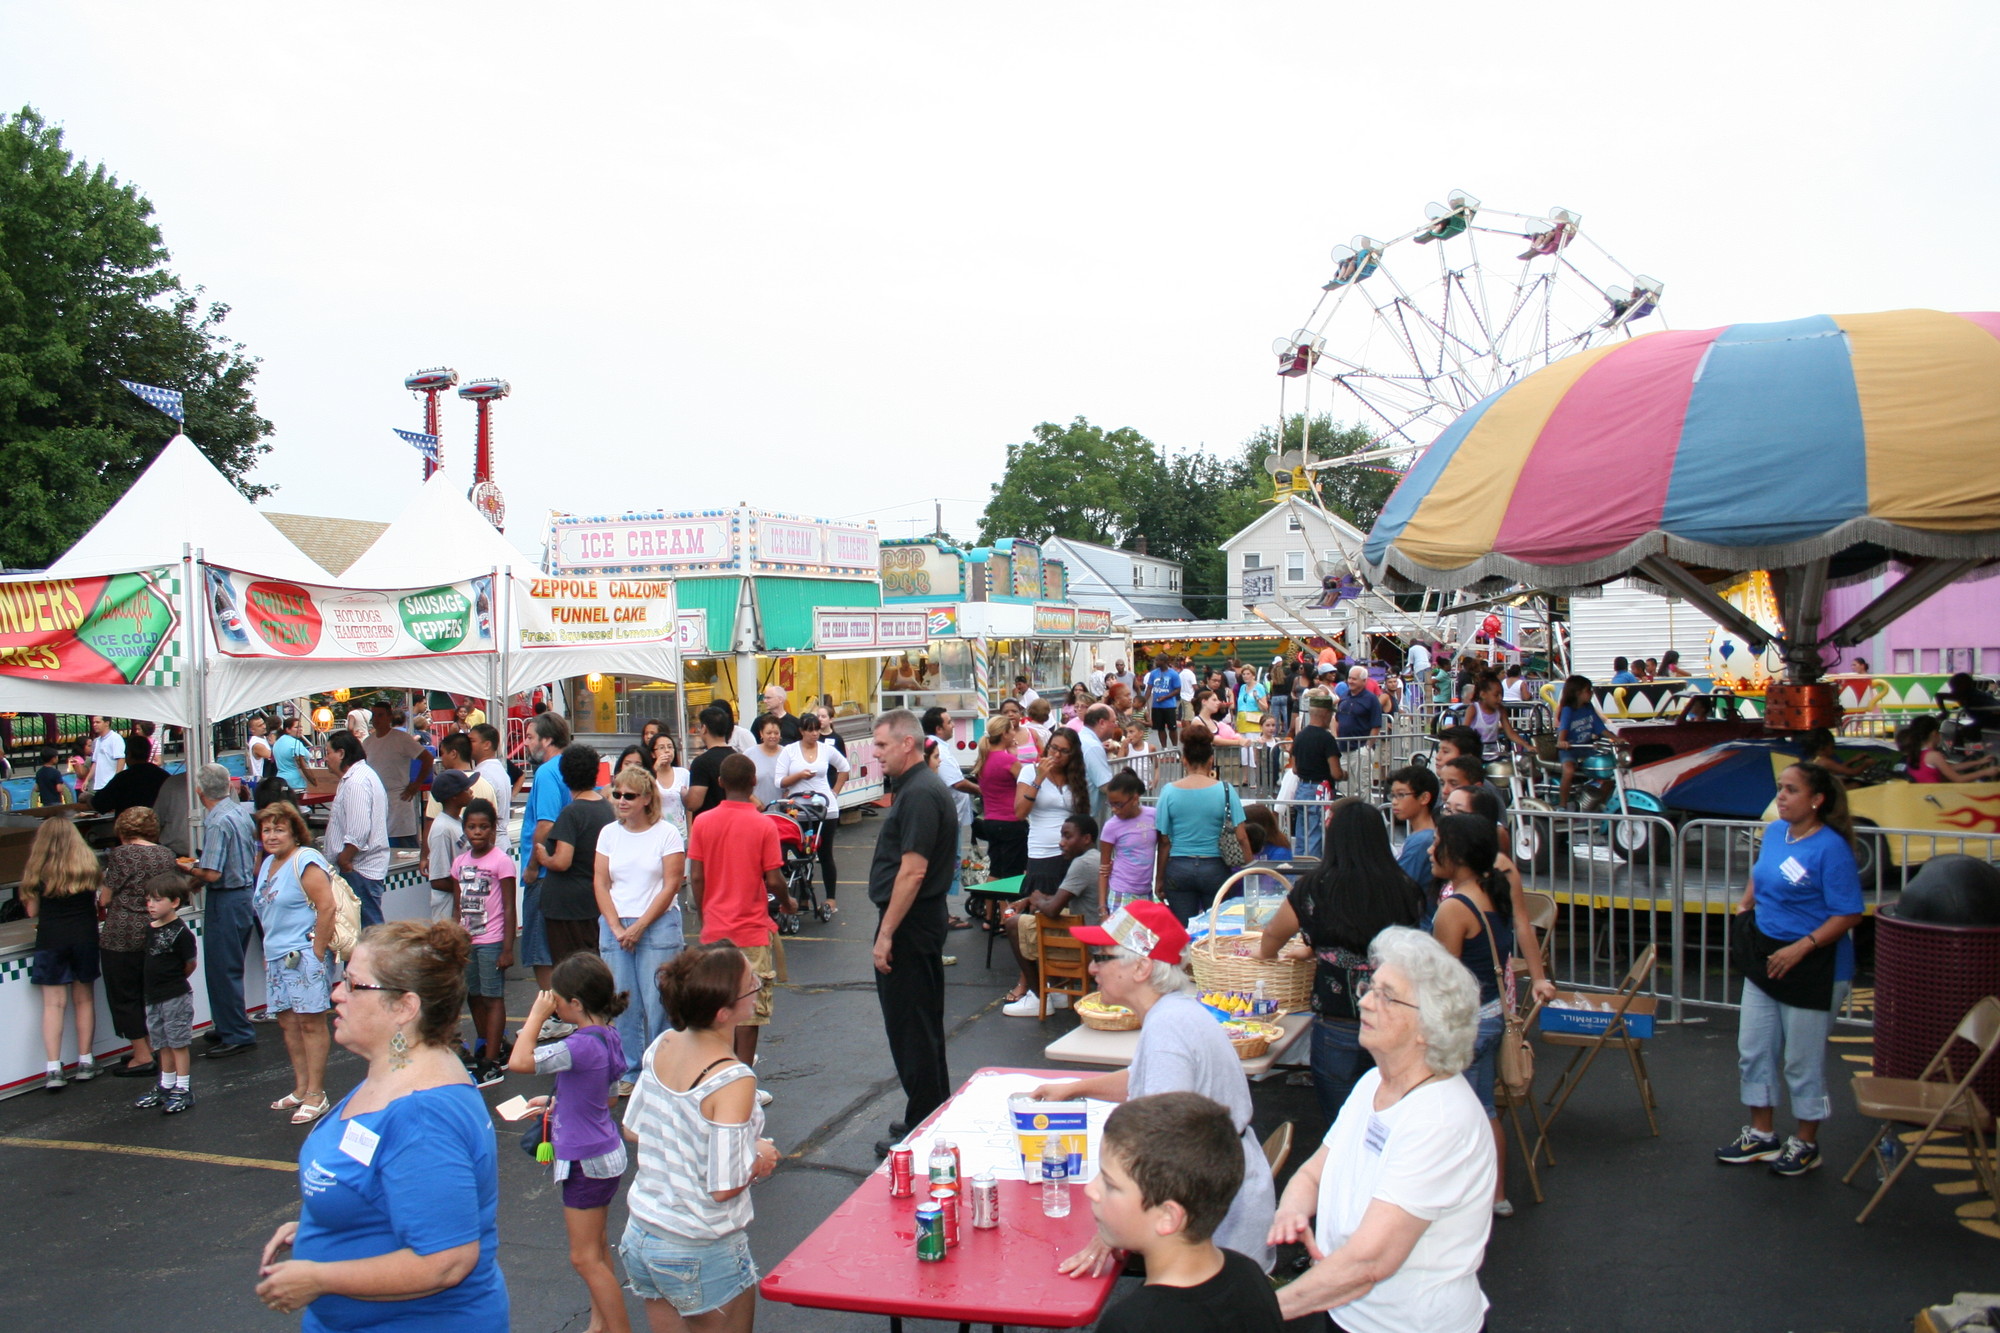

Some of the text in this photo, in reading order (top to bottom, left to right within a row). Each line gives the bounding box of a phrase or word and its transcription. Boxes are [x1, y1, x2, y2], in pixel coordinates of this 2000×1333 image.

[581, 528, 704, 558] ICE CREAM
[771, 527, 812, 556] ICE CREAM
[880, 548, 926, 572] POP
[530, 578, 668, 600] ZEPPOLE CALZONE
[0, 579, 85, 633] NDERS
[251, 591, 308, 615] PHILLY
[404, 594, 466, 615] SAUSAGE
[333, 609, 382, 622] HOT DOGS
[551, 606, 647, 624] FUNNEL CAKE
[1037, 613, 1072, 629] POPCORN
[261, 619, 313, 645] STEAK
[334, 625, 394, 638] HAMBURGERS
[411, 618, 462, 640] PEPPERS
[520, 628, 558, 643] Fresh
[560, 627, 613, 643] Squeezed
[92, 632, 158, 646] ICE COLD
[356, 641, 379, 653] FRIES
[106, 645, 151, 657] DRINKS
[1560, 1014, 1633, 1026] HMERMILL
